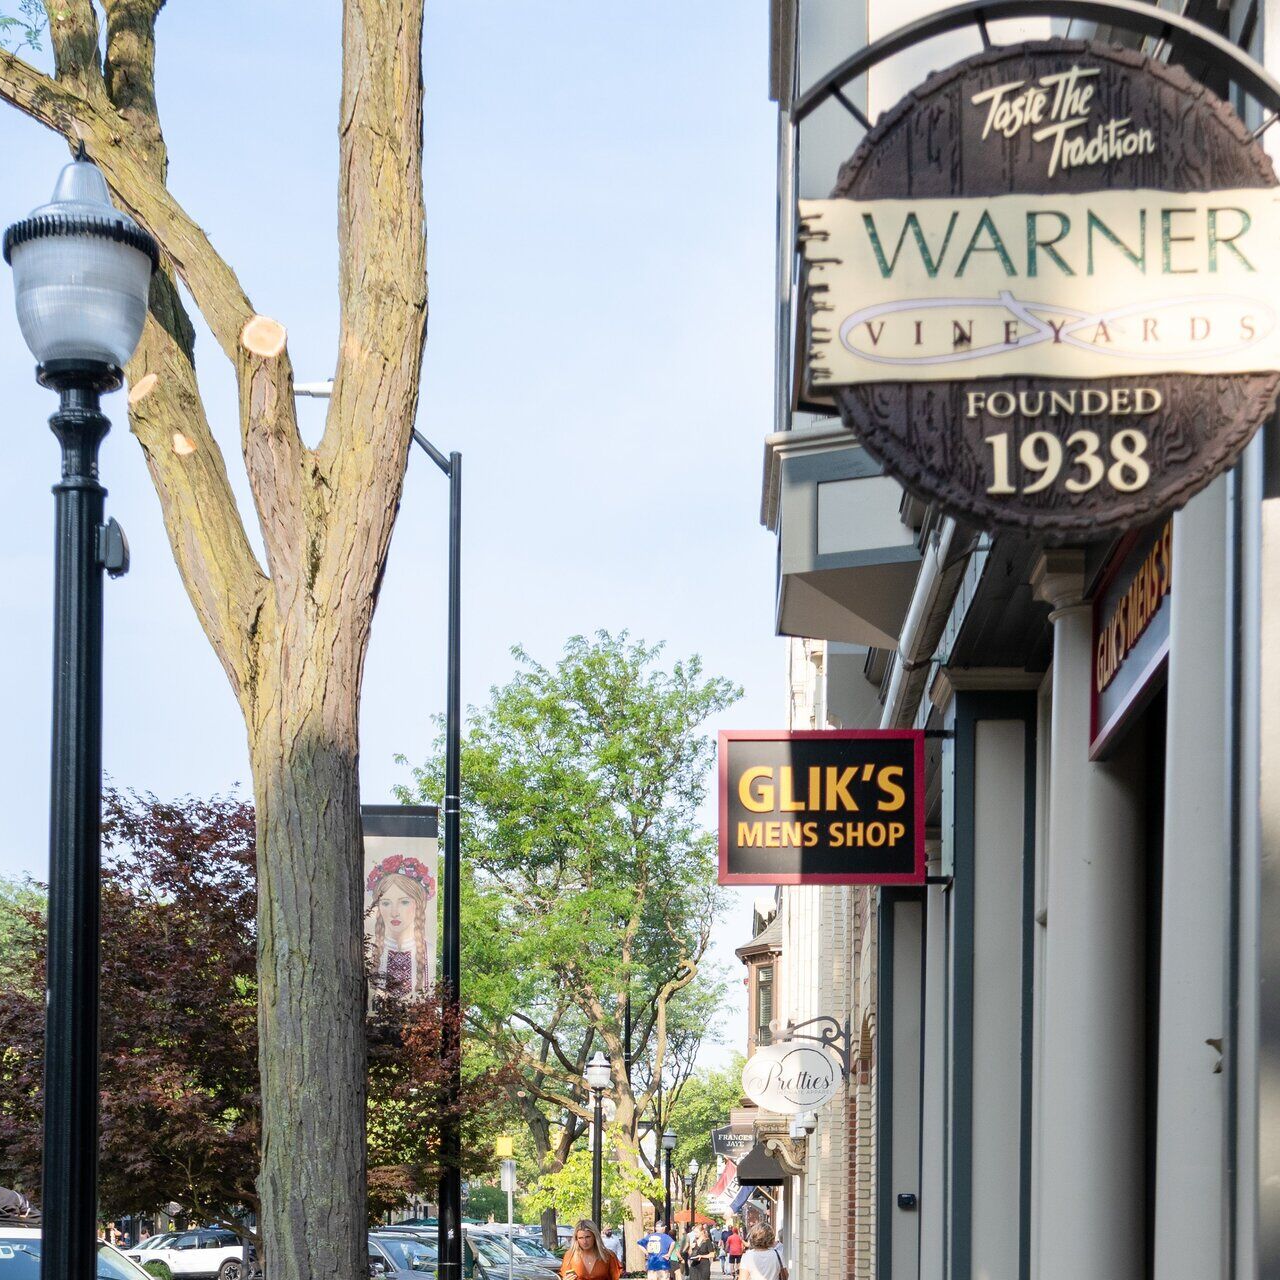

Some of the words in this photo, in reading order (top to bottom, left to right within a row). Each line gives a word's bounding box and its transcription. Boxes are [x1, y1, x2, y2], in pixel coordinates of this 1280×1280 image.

[972, 79, 1045, 140] Taste
[1040, 66, 1101, 118] The
[1033, 118, 1156, 178] Tradition
[861, 206, 1257, 280] WARNER
[864, 317, 1257, 347] VINEYARDS
[966, 387, 1162, 419] FOUNDED
[984, 428, 1151, 495] 1938
[737, 763, 907, 815] GLIK'S
[736, 821, 818, 849] MENS
[828, 821, 906, 848] SHOP
[718, 1134, 753, 1142] FRANCES
